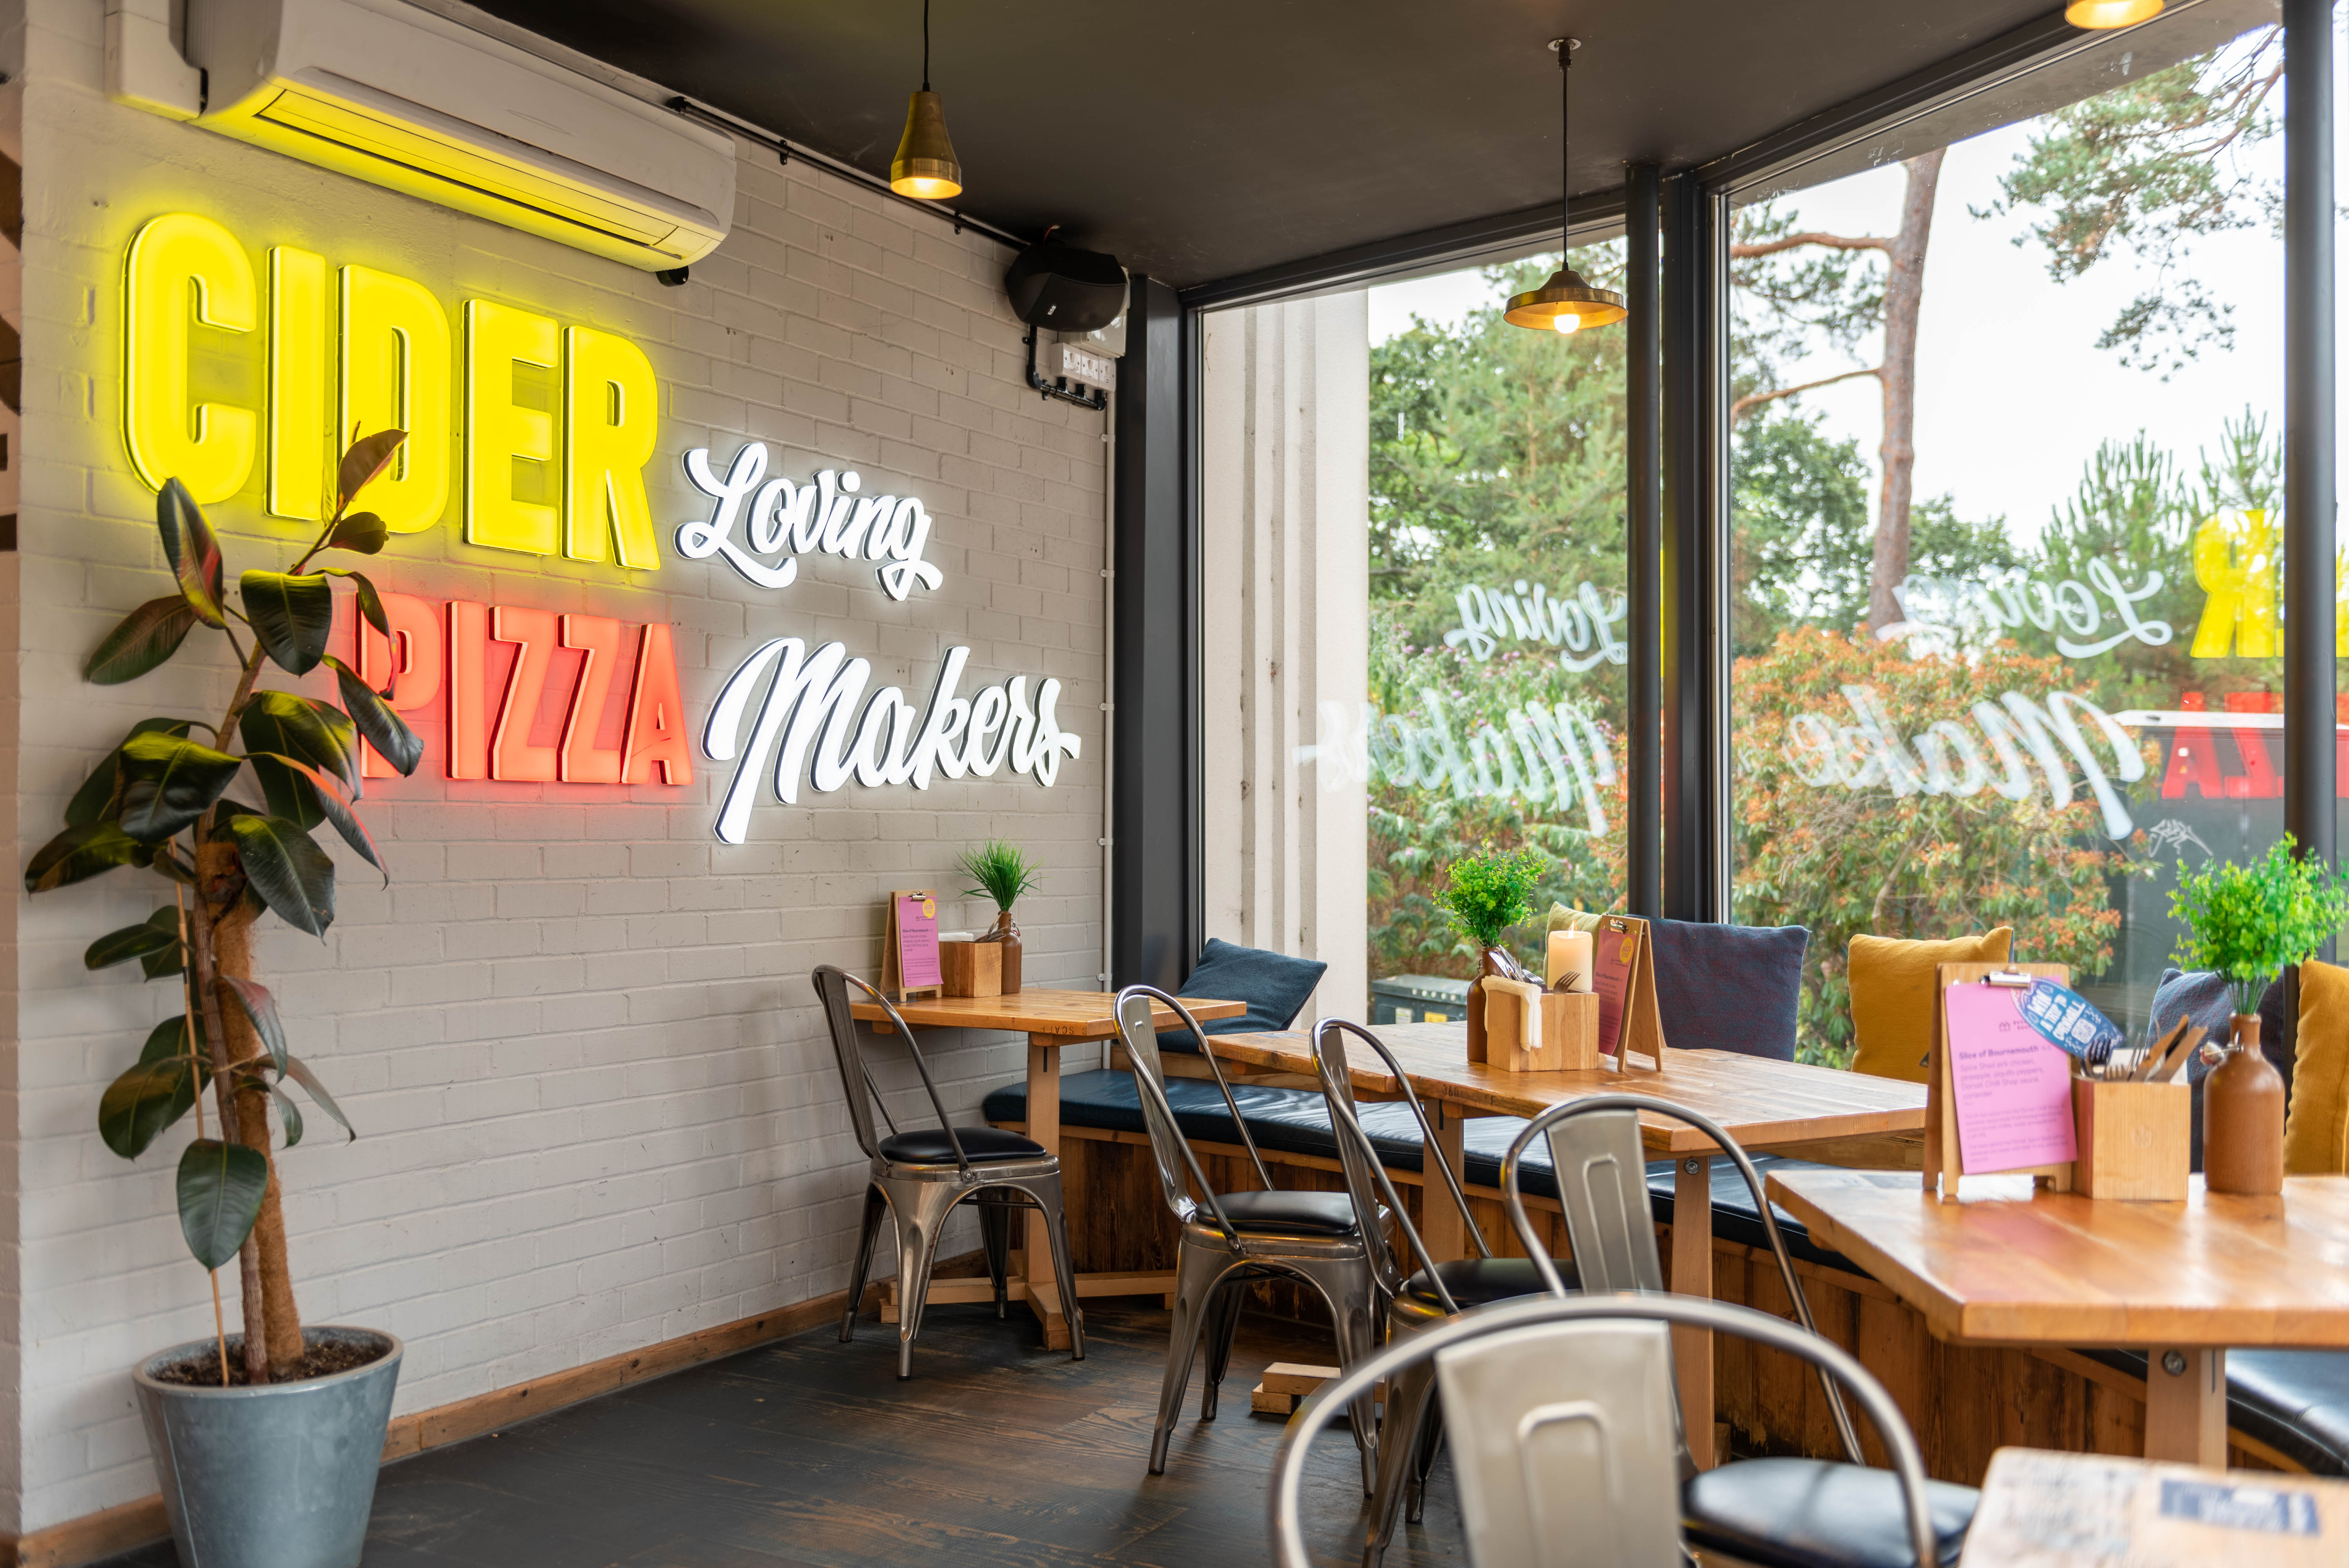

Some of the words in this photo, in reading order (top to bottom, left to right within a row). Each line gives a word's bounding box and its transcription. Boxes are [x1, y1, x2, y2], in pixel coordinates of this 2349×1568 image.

[124, 212, 661, 571] CIDER
[675, 442, 943, 601] Loving
[355, 591, 693, 785] PIZZA
[702, 637, 1081, 845] Makers
